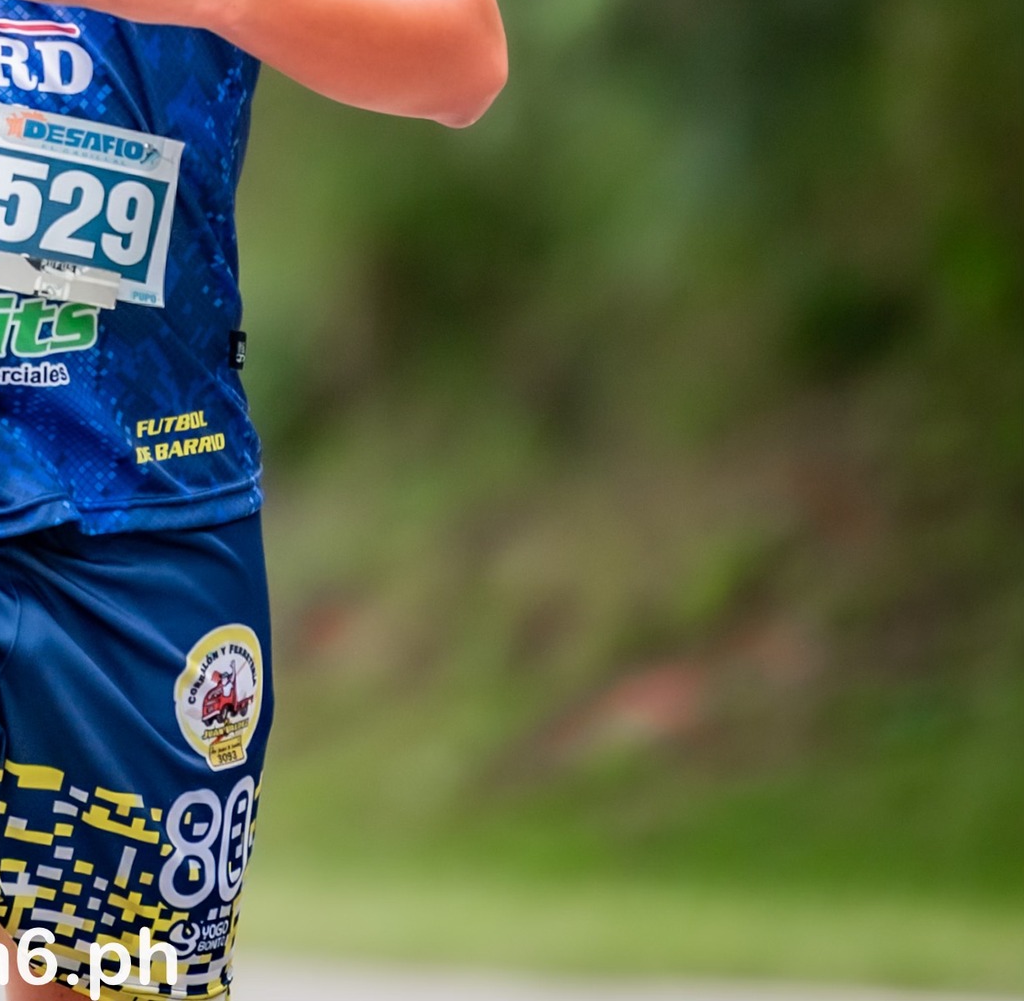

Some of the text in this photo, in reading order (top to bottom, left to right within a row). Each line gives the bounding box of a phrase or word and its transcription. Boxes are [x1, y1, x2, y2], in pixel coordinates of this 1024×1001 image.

[23, 119, 144, 160] DESAFIO
[136, 410, 208, 438] FUTBOL
[155, 433, 225, 461] BARRIO
[159, 775, 255, 909] 80
[202, 920, 229, 940] YOGO
